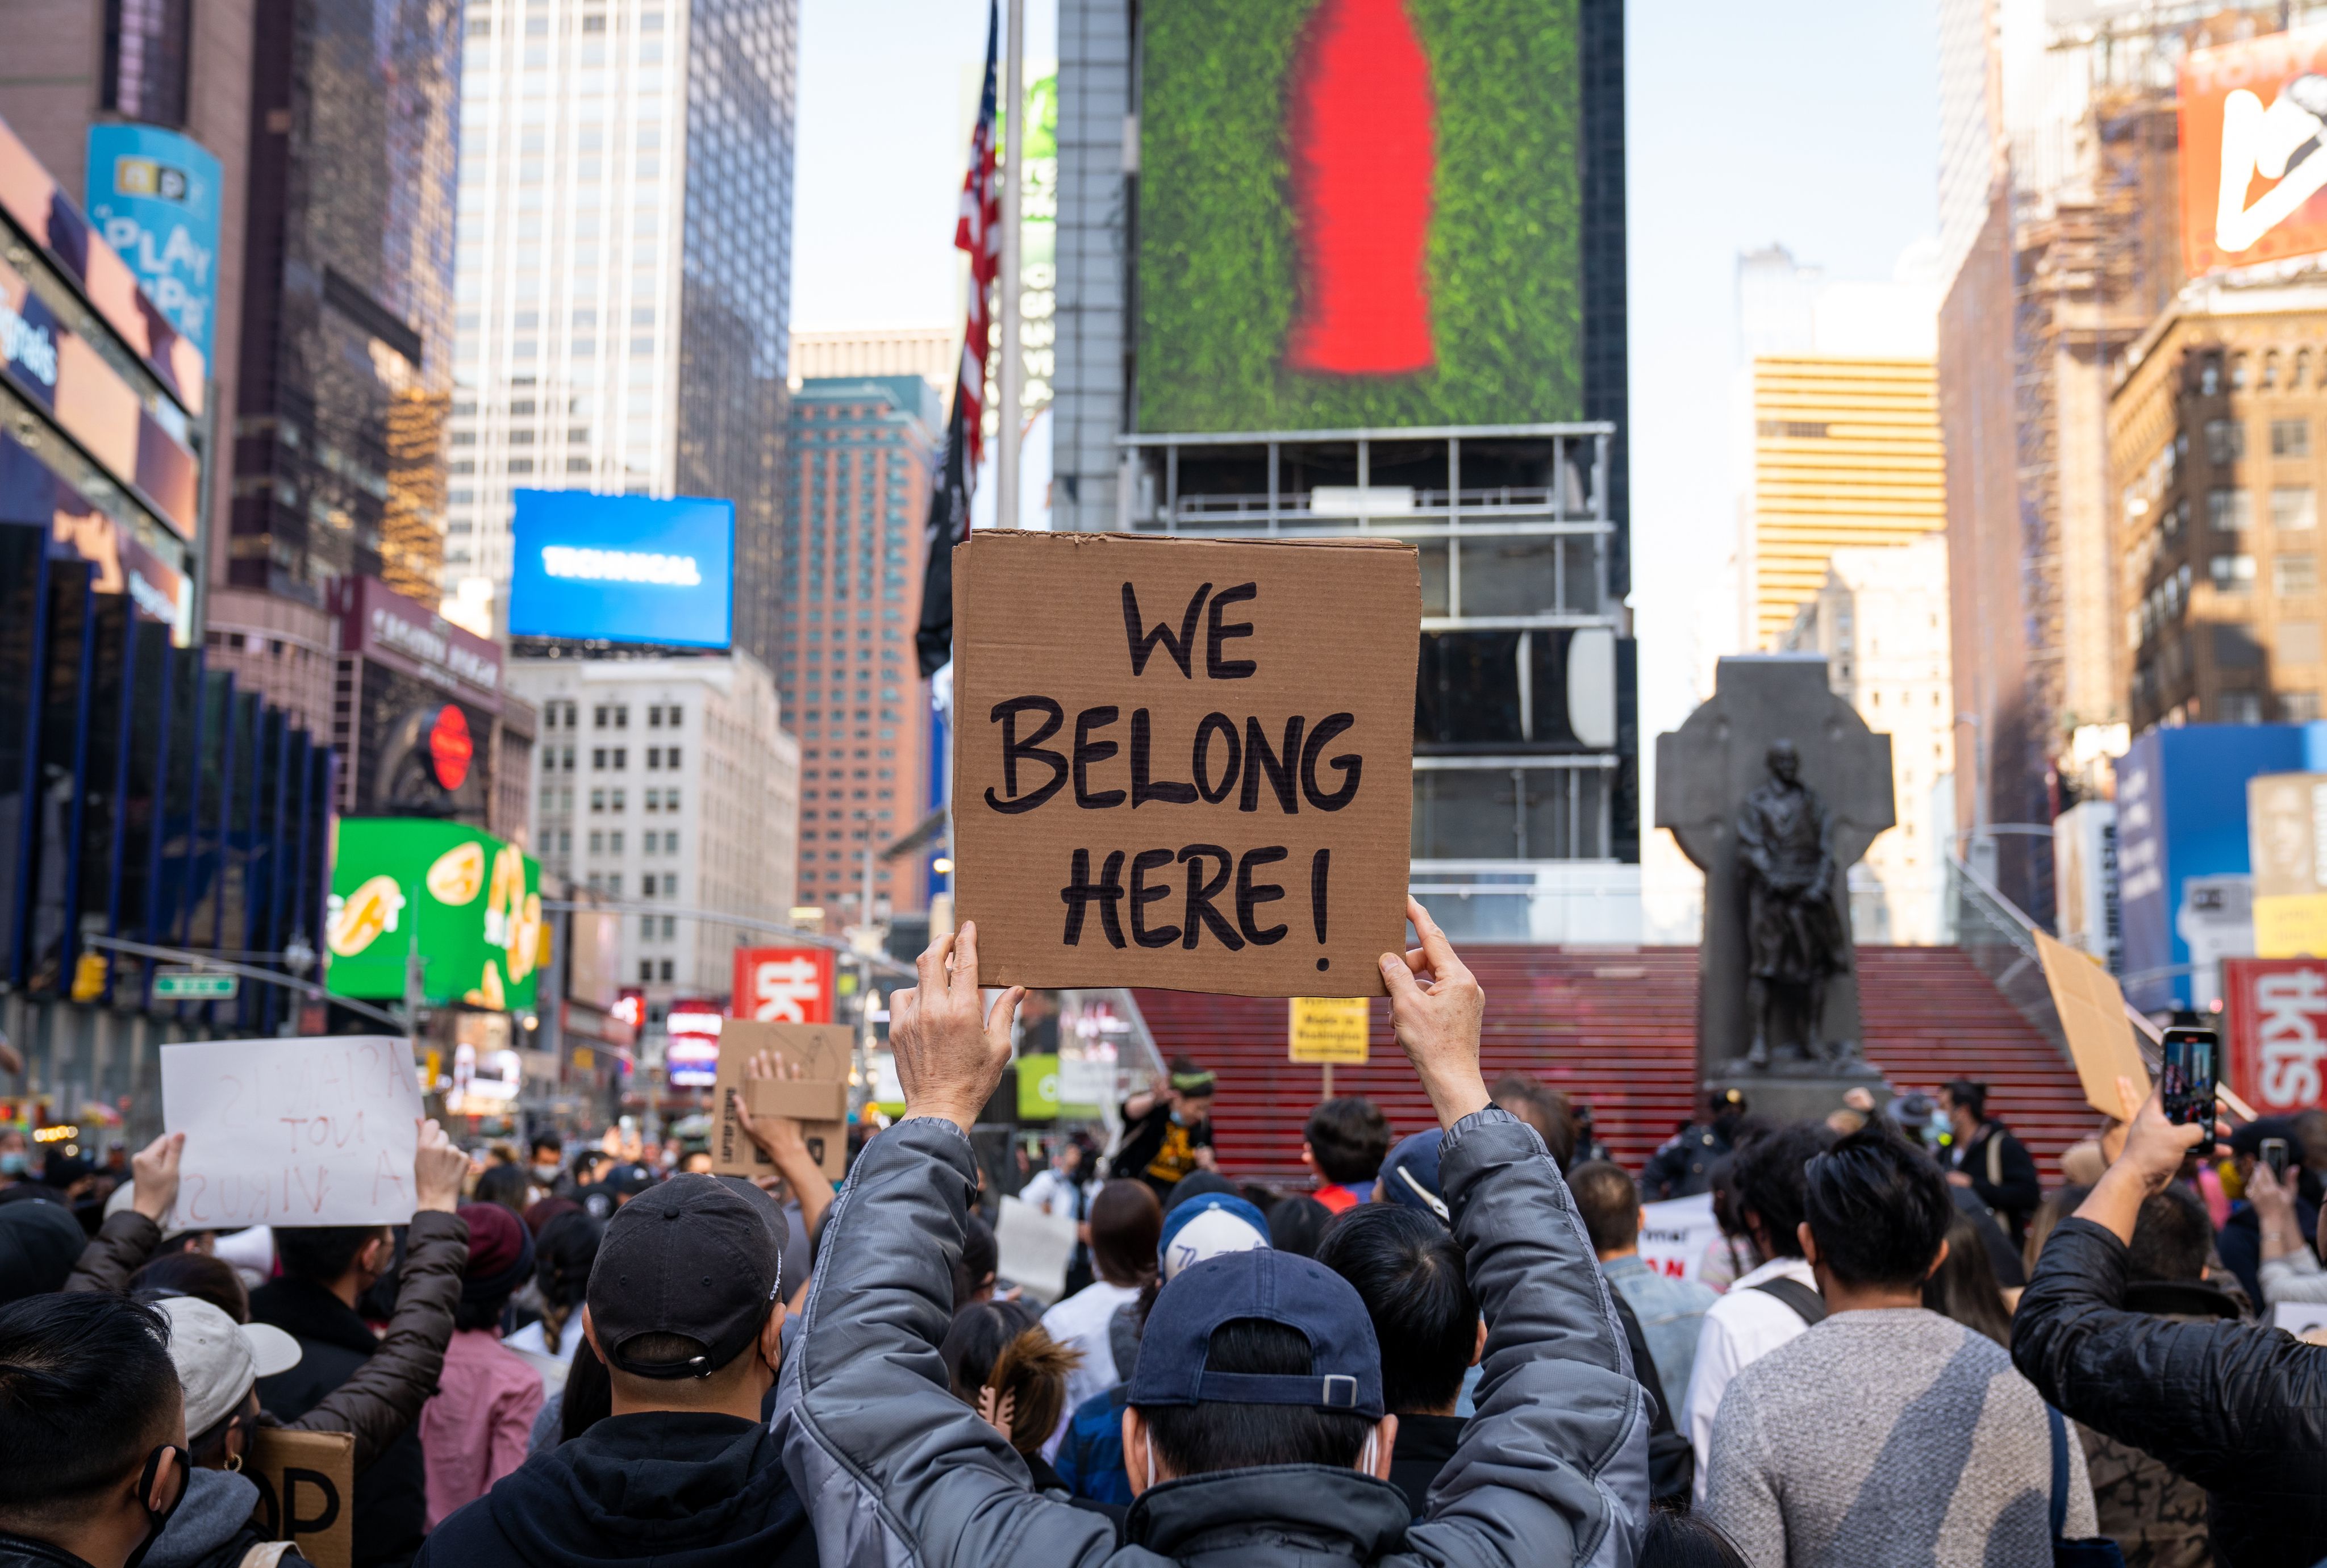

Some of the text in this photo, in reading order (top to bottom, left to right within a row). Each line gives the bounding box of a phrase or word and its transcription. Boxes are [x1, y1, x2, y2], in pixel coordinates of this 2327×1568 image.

[1121, 580, 1257, 679] WE
[984, 695, 1362, 815] BELONG
[1061, 844, 1330, 972] HERE!
[754, 955, 820, 1023] tk
[2254, 968, 2327, 1108] tkts
